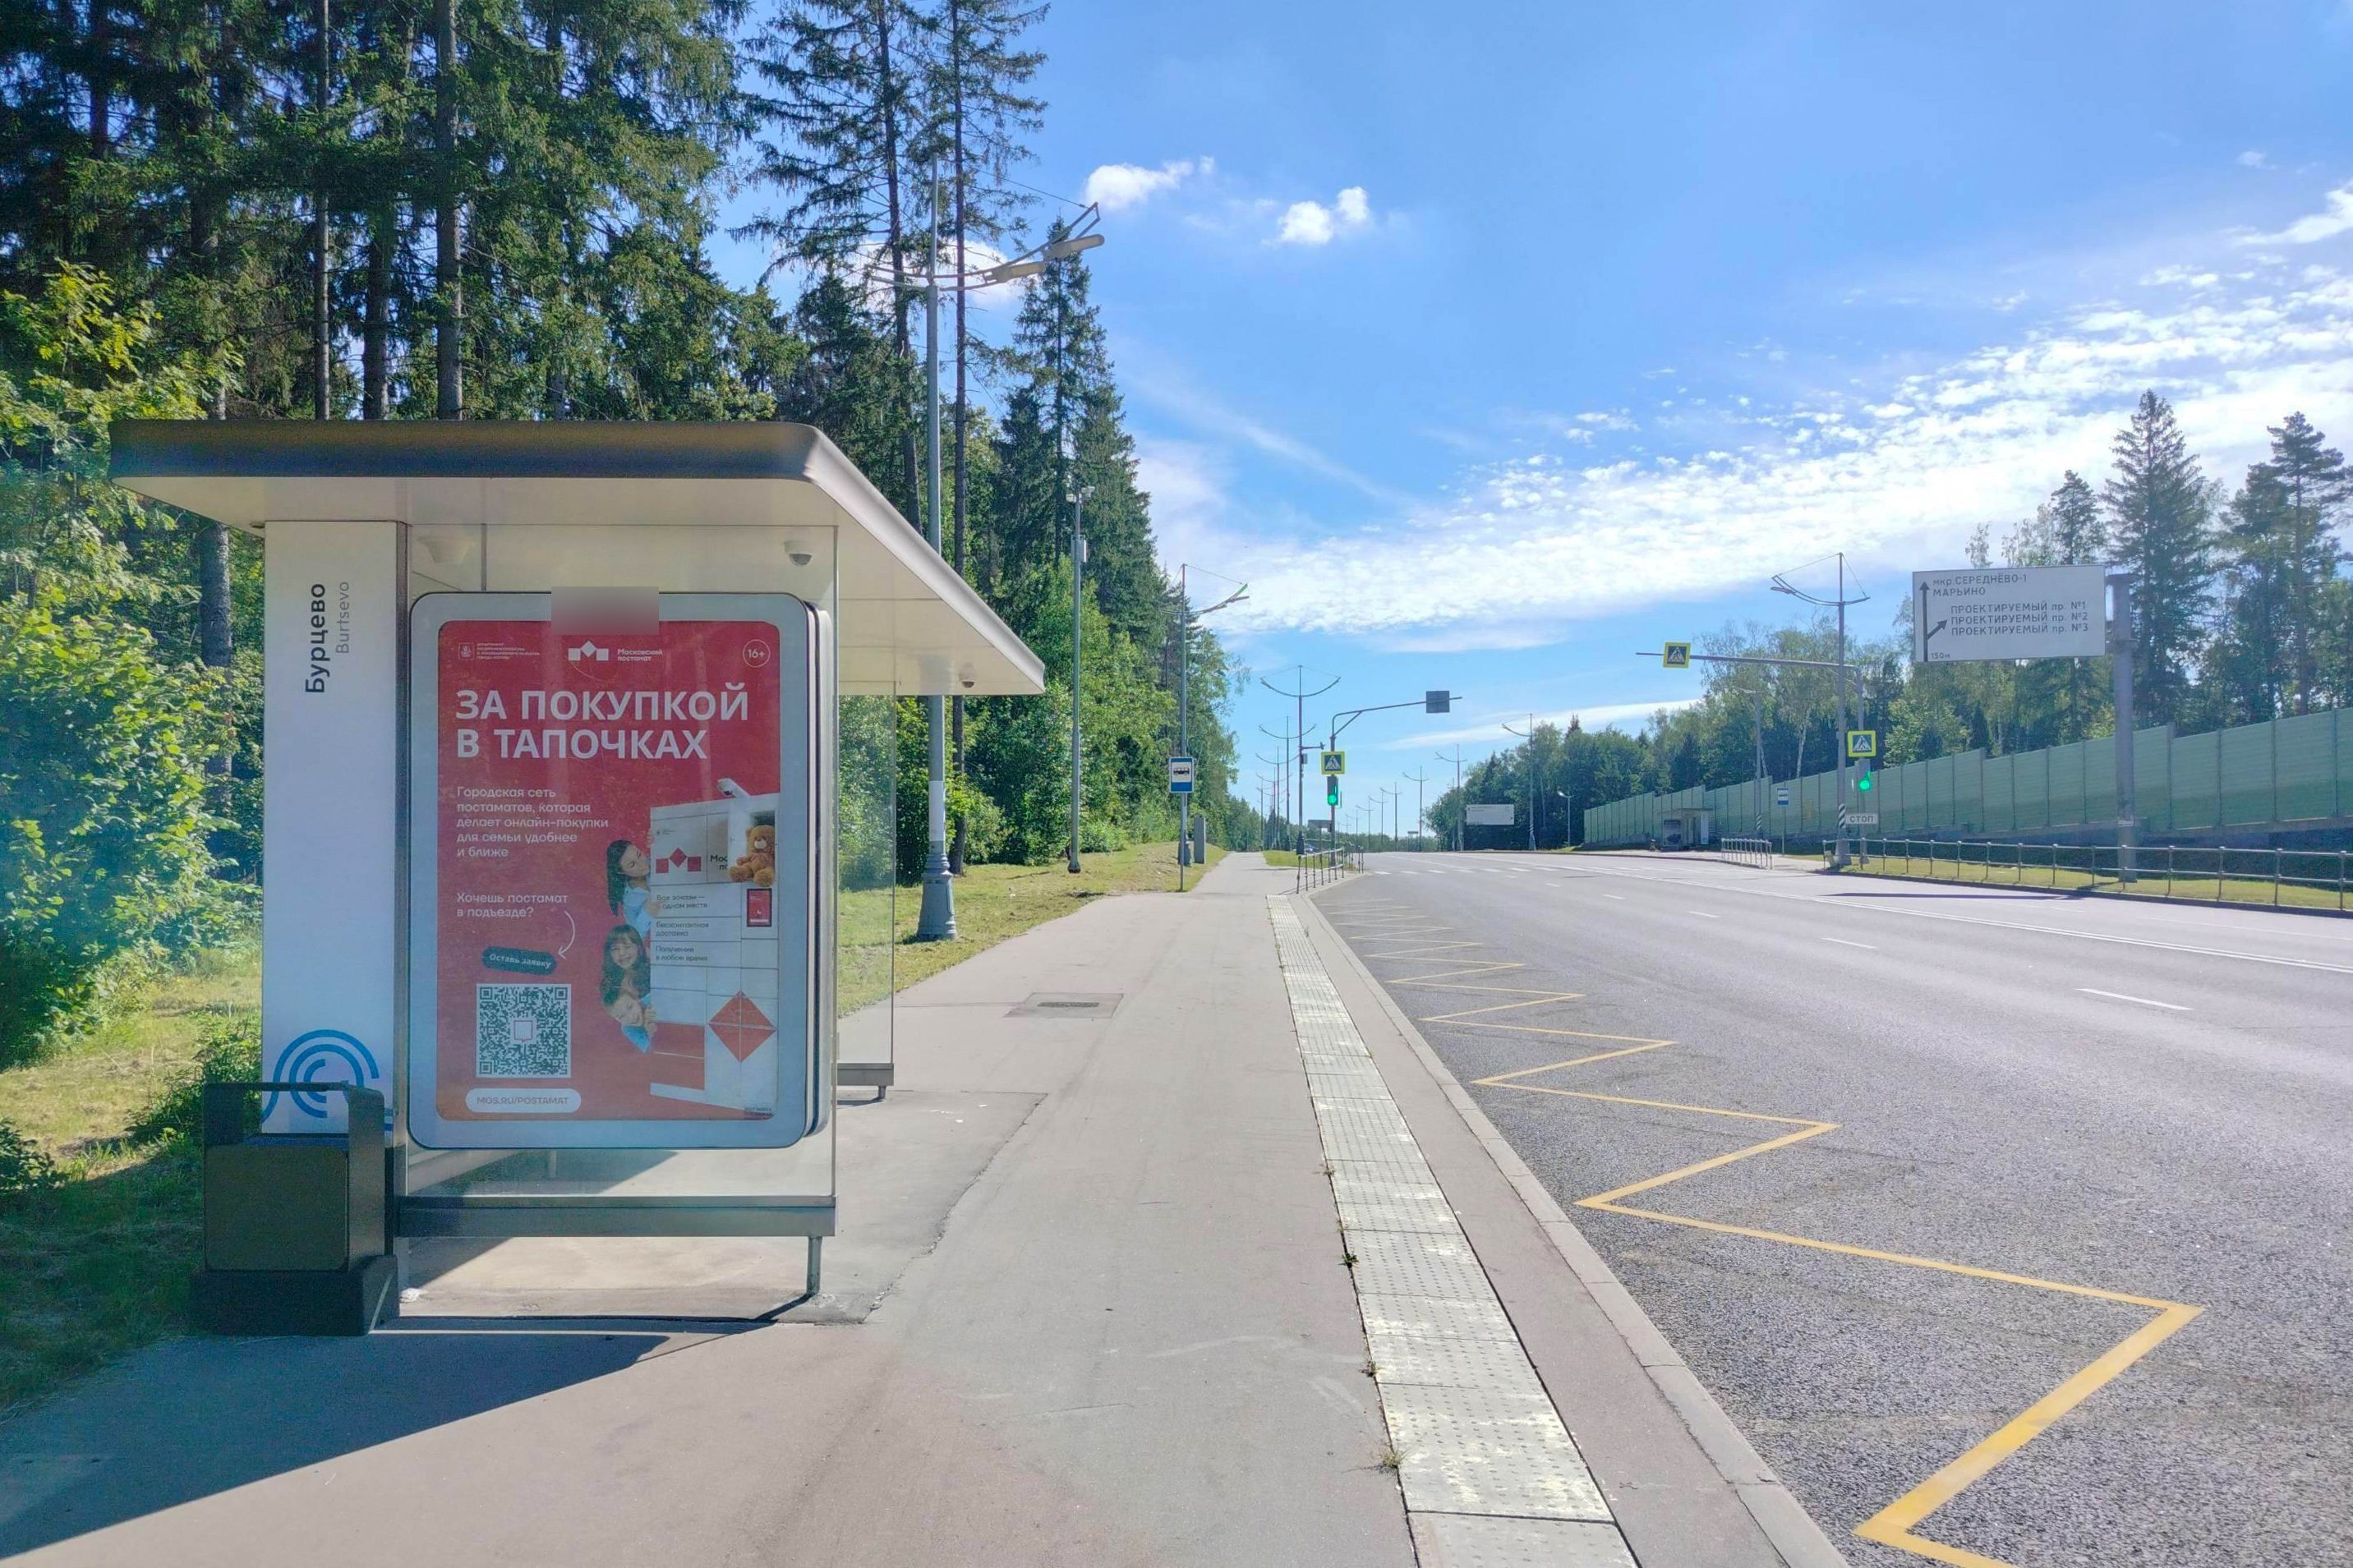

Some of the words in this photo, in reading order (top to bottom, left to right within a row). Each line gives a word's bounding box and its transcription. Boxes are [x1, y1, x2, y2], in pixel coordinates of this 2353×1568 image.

[1932, 586, 1986, 596] МАРЬИНО
[1950, 600, 2047, 614] ПРОЕКТИРУЕМЫЙ
[335, 582, 349, 654] Burtsevo
[1950, 612, 2047, 625] ПРОЕКТИРУЕМЫЙ
[2071, 613, 2088, 621] №2
[1951, 623, 2048, 636] ПРОЕКТИРУЕМЫЙ
[2071, 623, 2088, 632] №3
[305, 583, 330, 693] Бурцево
[747, 648, 765, 659] 16+
[456, 690, 506, 720] ЗА
[521, 682, 748, 720] ПОКУПКОЙ
[457, 729, 480, 758] В
[495, 729, 707, 759] ТАПОЧКАХ
[457, 787, 524, 799] Городская
[527, 789, 556, 798] сеть
[457, 803, 536, 813] постаматов,
[539, 804, 591, 814] которая
[457, 818, 500, 828] делает
[504, 816, 609, 830] онлайн-покупки
[457, 834, 478, 843] для
[482, 833, 522, 842] семьи
[525, 831, 578, 844] удобнее
[457, 848, 465, 857] и
[468, 846, 509, 857] ближе
[456, 892, 505, 904] Хочешь
[508, 894, 569, 904] постамат
[457, 908, 463, 917] в
[467, 907, 535, 918] подъезде?
[489, 954, 520, 964] Оставь
[521, 959, 552, 969] заявку
[477, 1097, 569, 1105] MOS.RU/POSTAMAT
